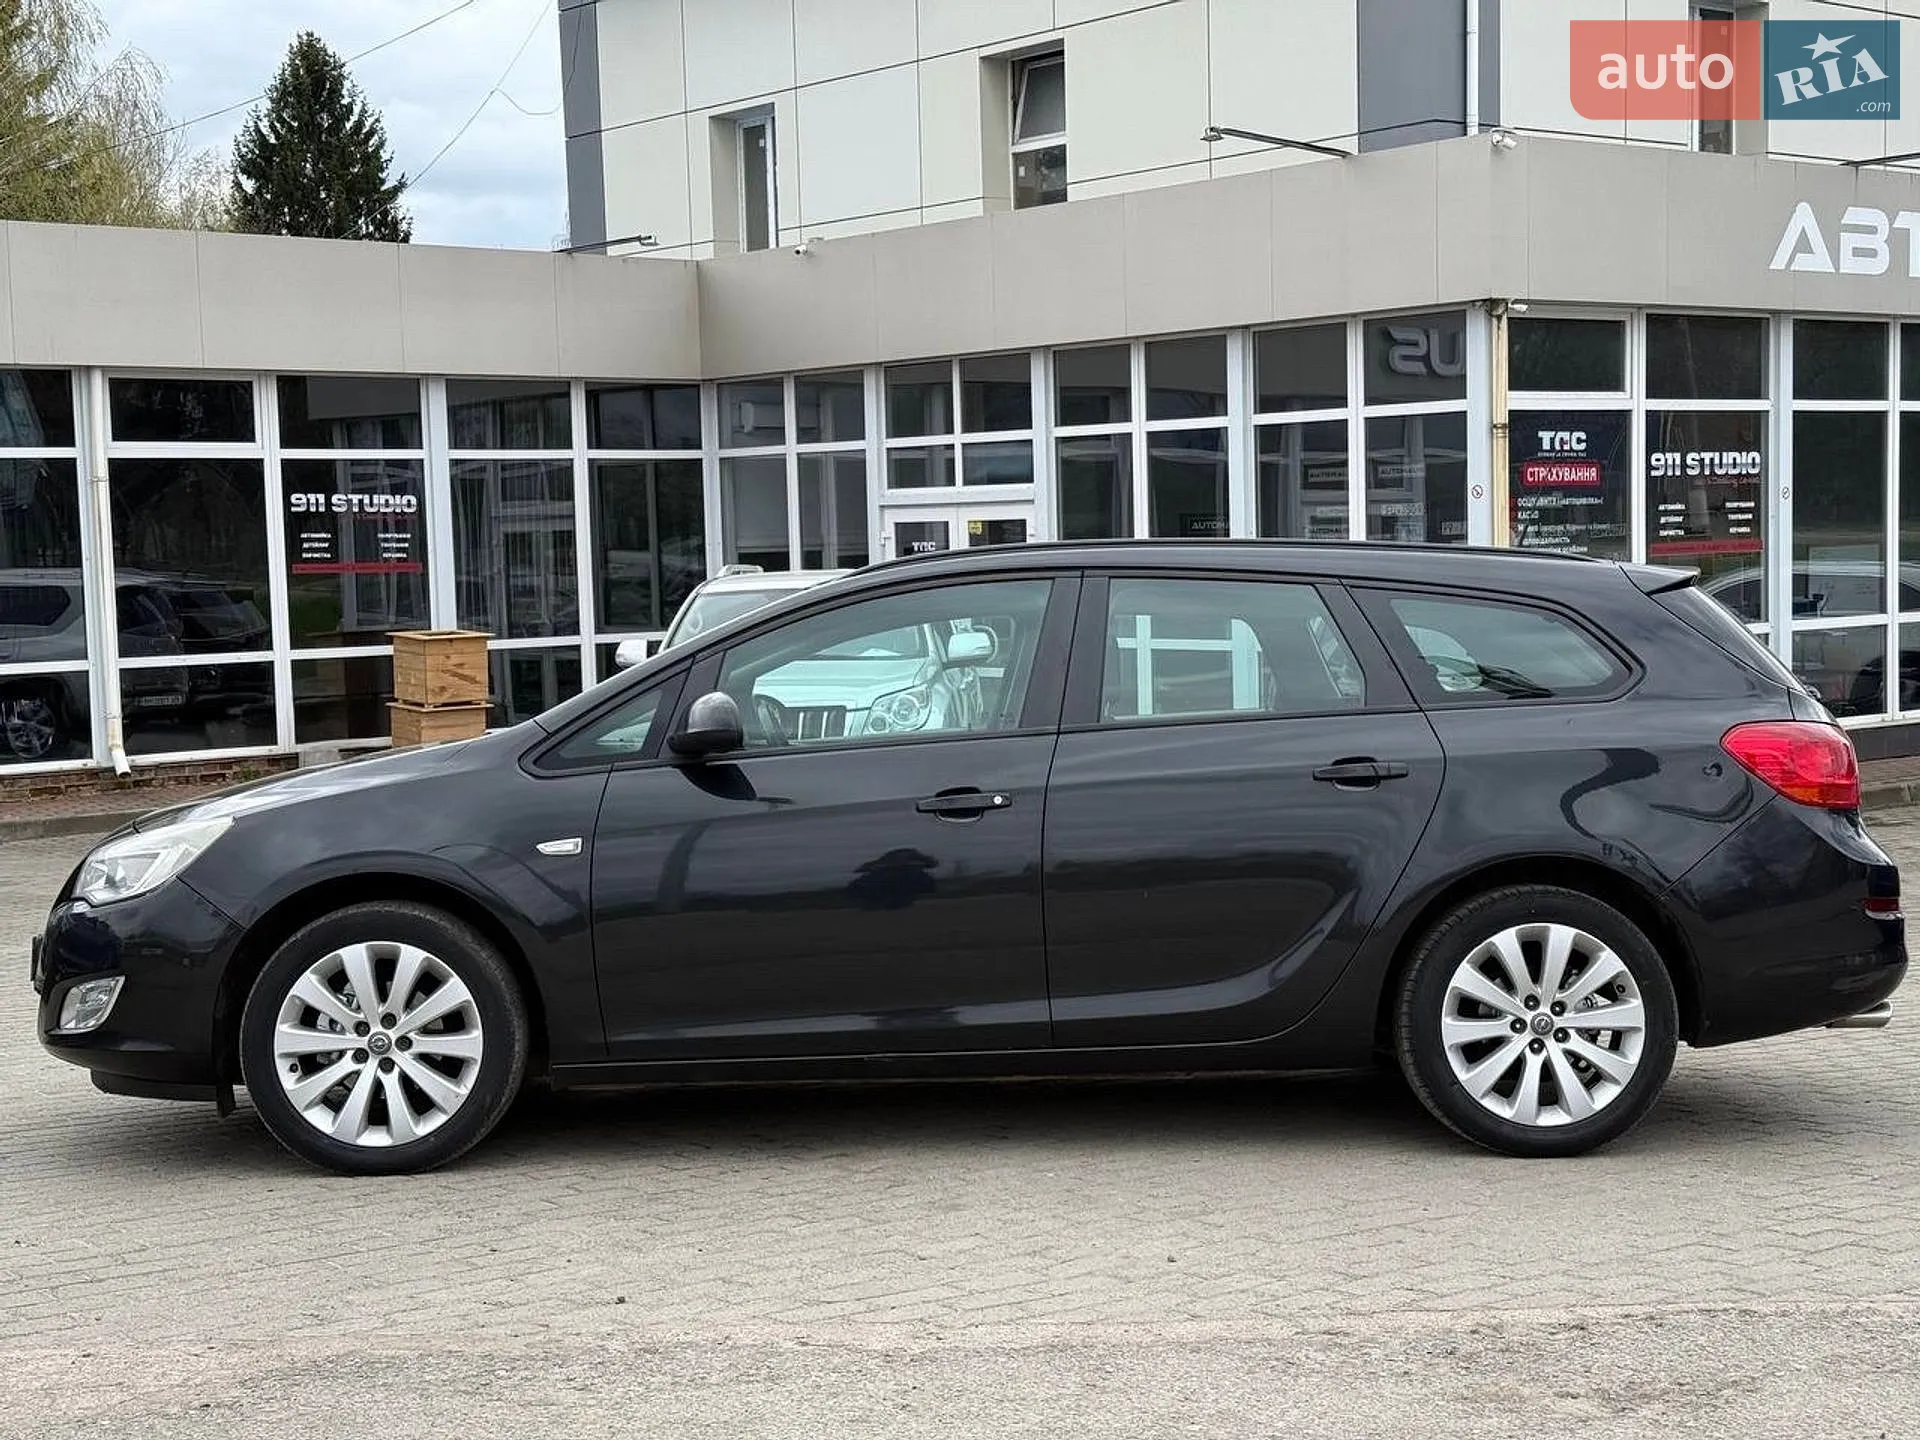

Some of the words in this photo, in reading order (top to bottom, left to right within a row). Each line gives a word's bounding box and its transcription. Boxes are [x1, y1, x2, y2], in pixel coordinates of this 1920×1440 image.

[1650, 451, 1681, 477] 911
[1686, 451, 1761, 476] STUDIO
[290, 493, 326, 513] 911
[331, 493, 417, 513] STUDIO
